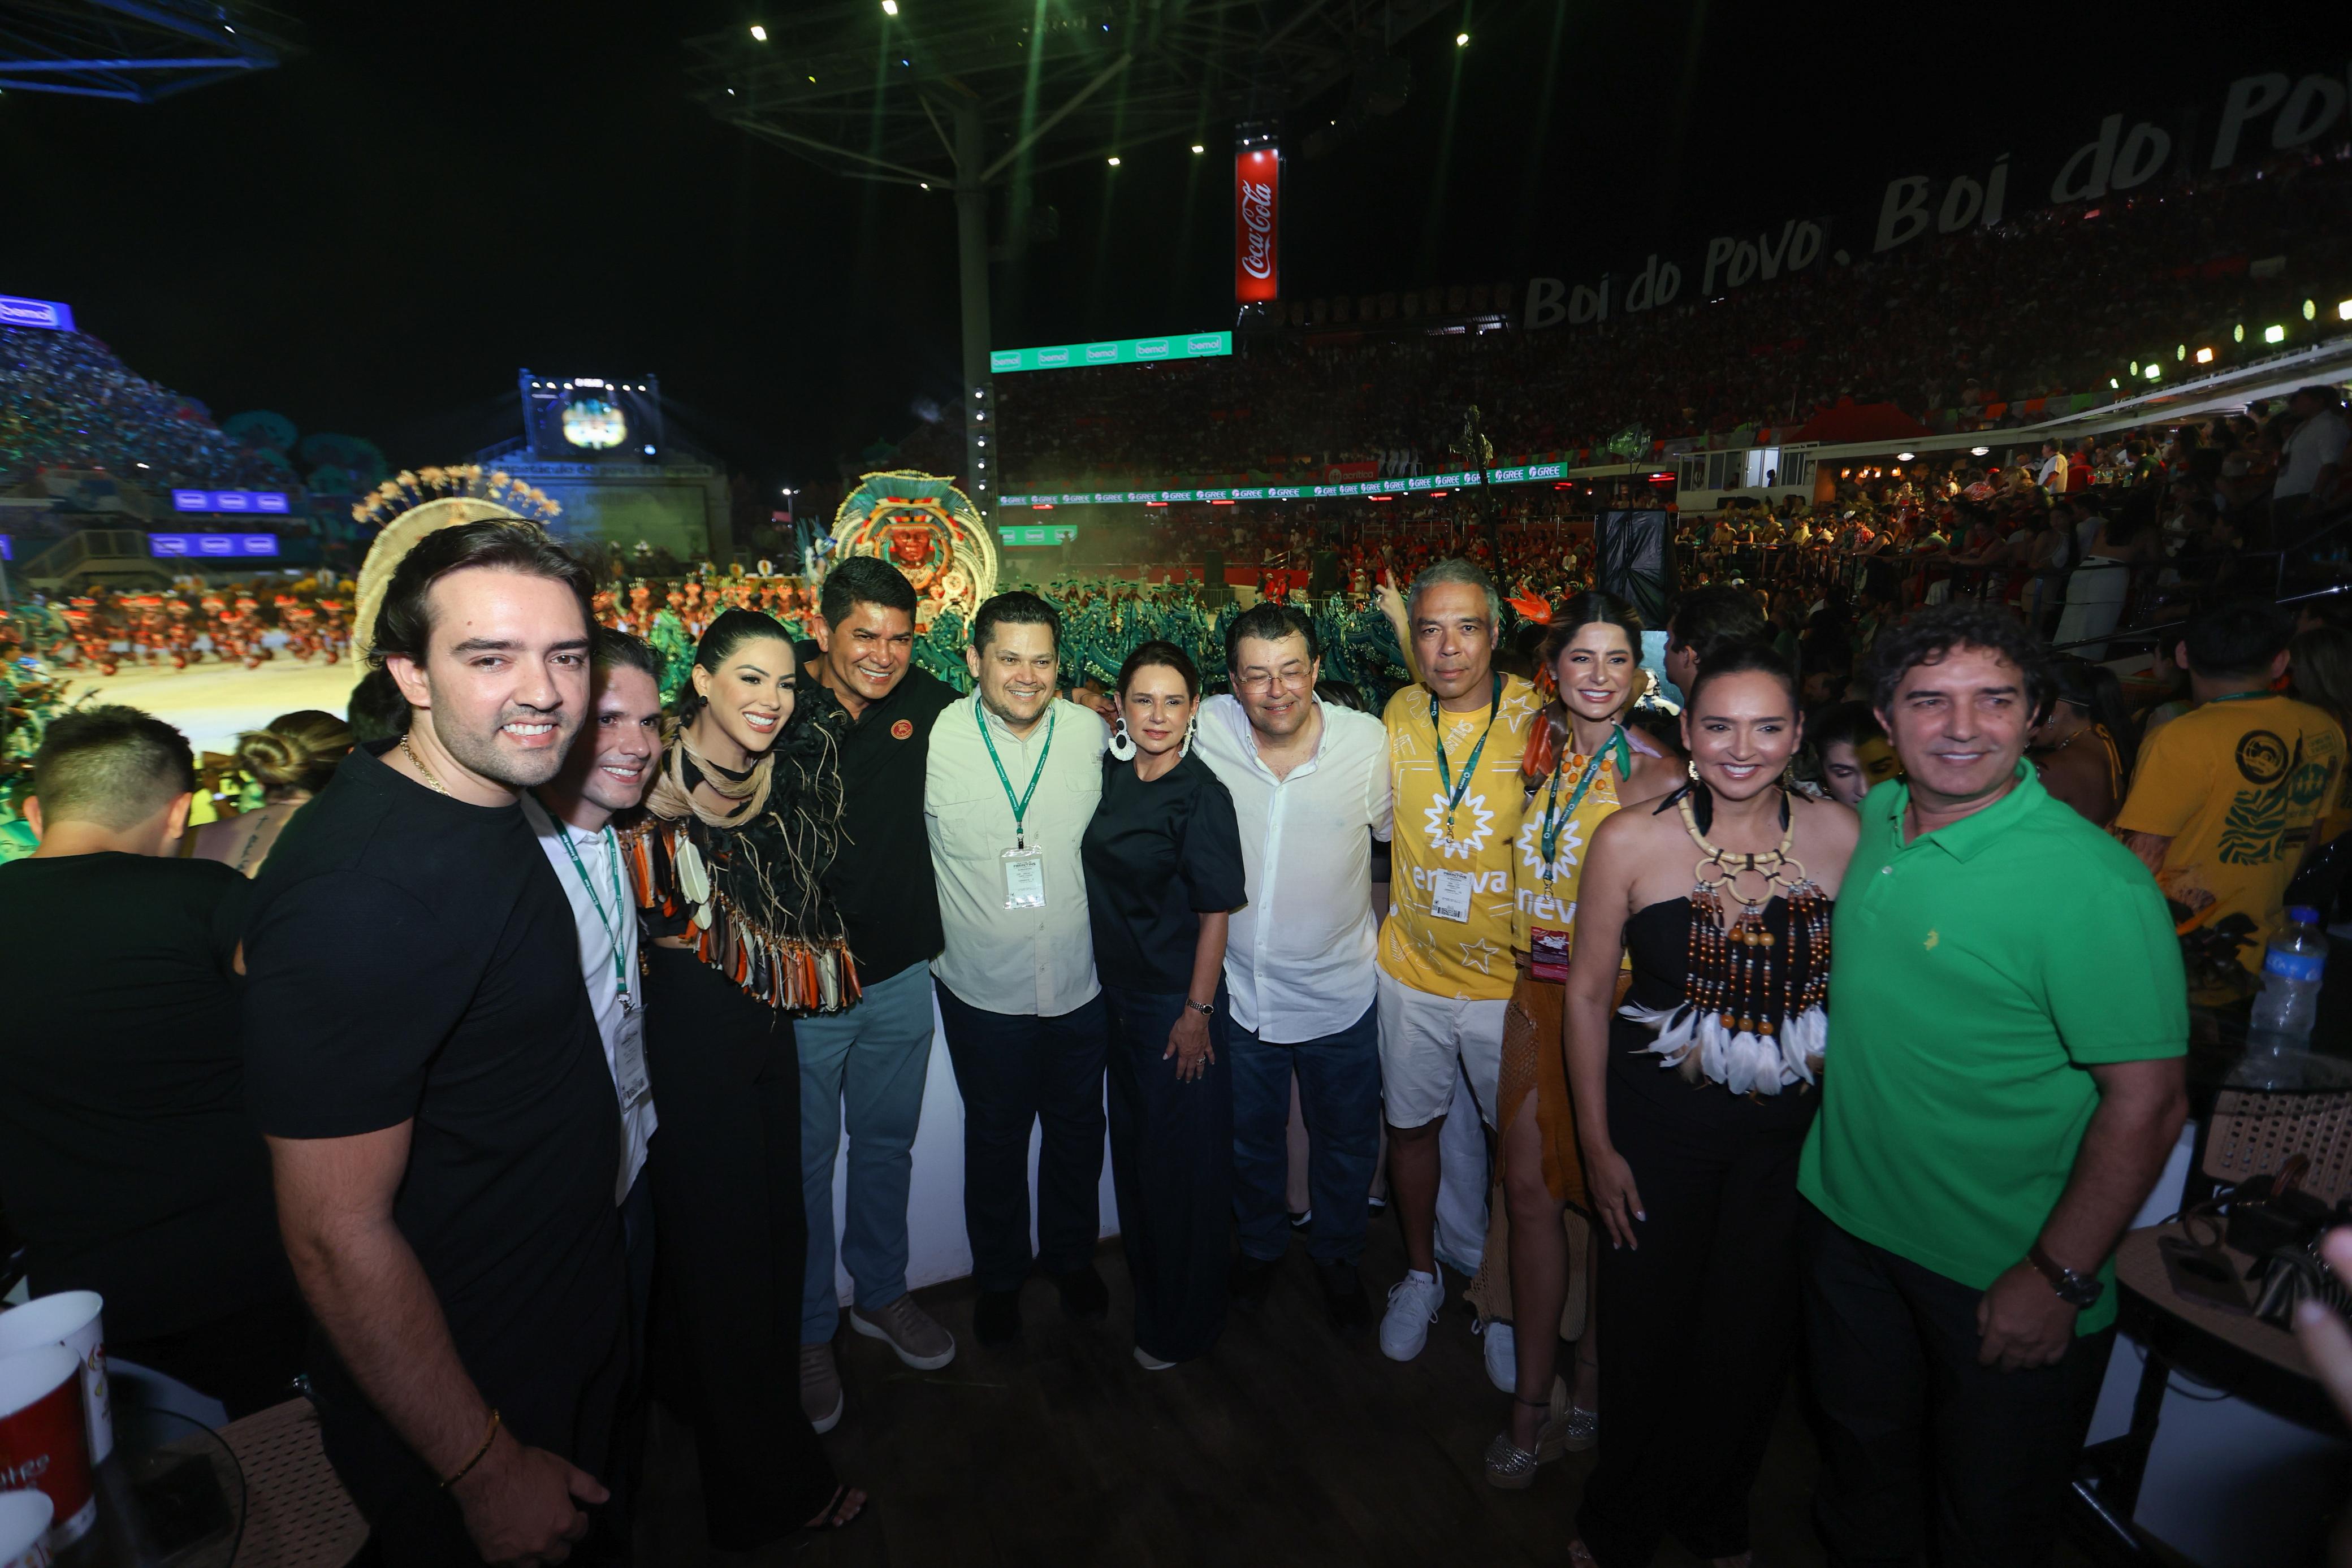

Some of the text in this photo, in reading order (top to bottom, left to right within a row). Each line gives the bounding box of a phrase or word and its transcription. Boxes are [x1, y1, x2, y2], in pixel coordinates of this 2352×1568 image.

[1523, 272, 1610, 330] Boi
[1625, 253, 1681, 313] do
[1873, 151, 2011, 254] Boi
[2050, 113, 2172, 204] do
[2210, 72, 2352, 170] Po
[1138, 344, 1166, 354] bemol
[1190, 340, 1220, 350] bemol
[1040, 353, 1067, 363] bemol
[1088, 349, 1117, 359] bemol
[993, 356, 1021, 366] bemol
[1503, 469, 1524, 479] GREE
[1537, 465, 1560, 477] GREE
[1441, 475, 1460, 485] GREE
[1471, 473, 1491, 482] GRE
[1389, 480, 1406, 491] GREE
[1414, 478, 1431, 488] GREE
[1413, 866, 1507, 894] enva
